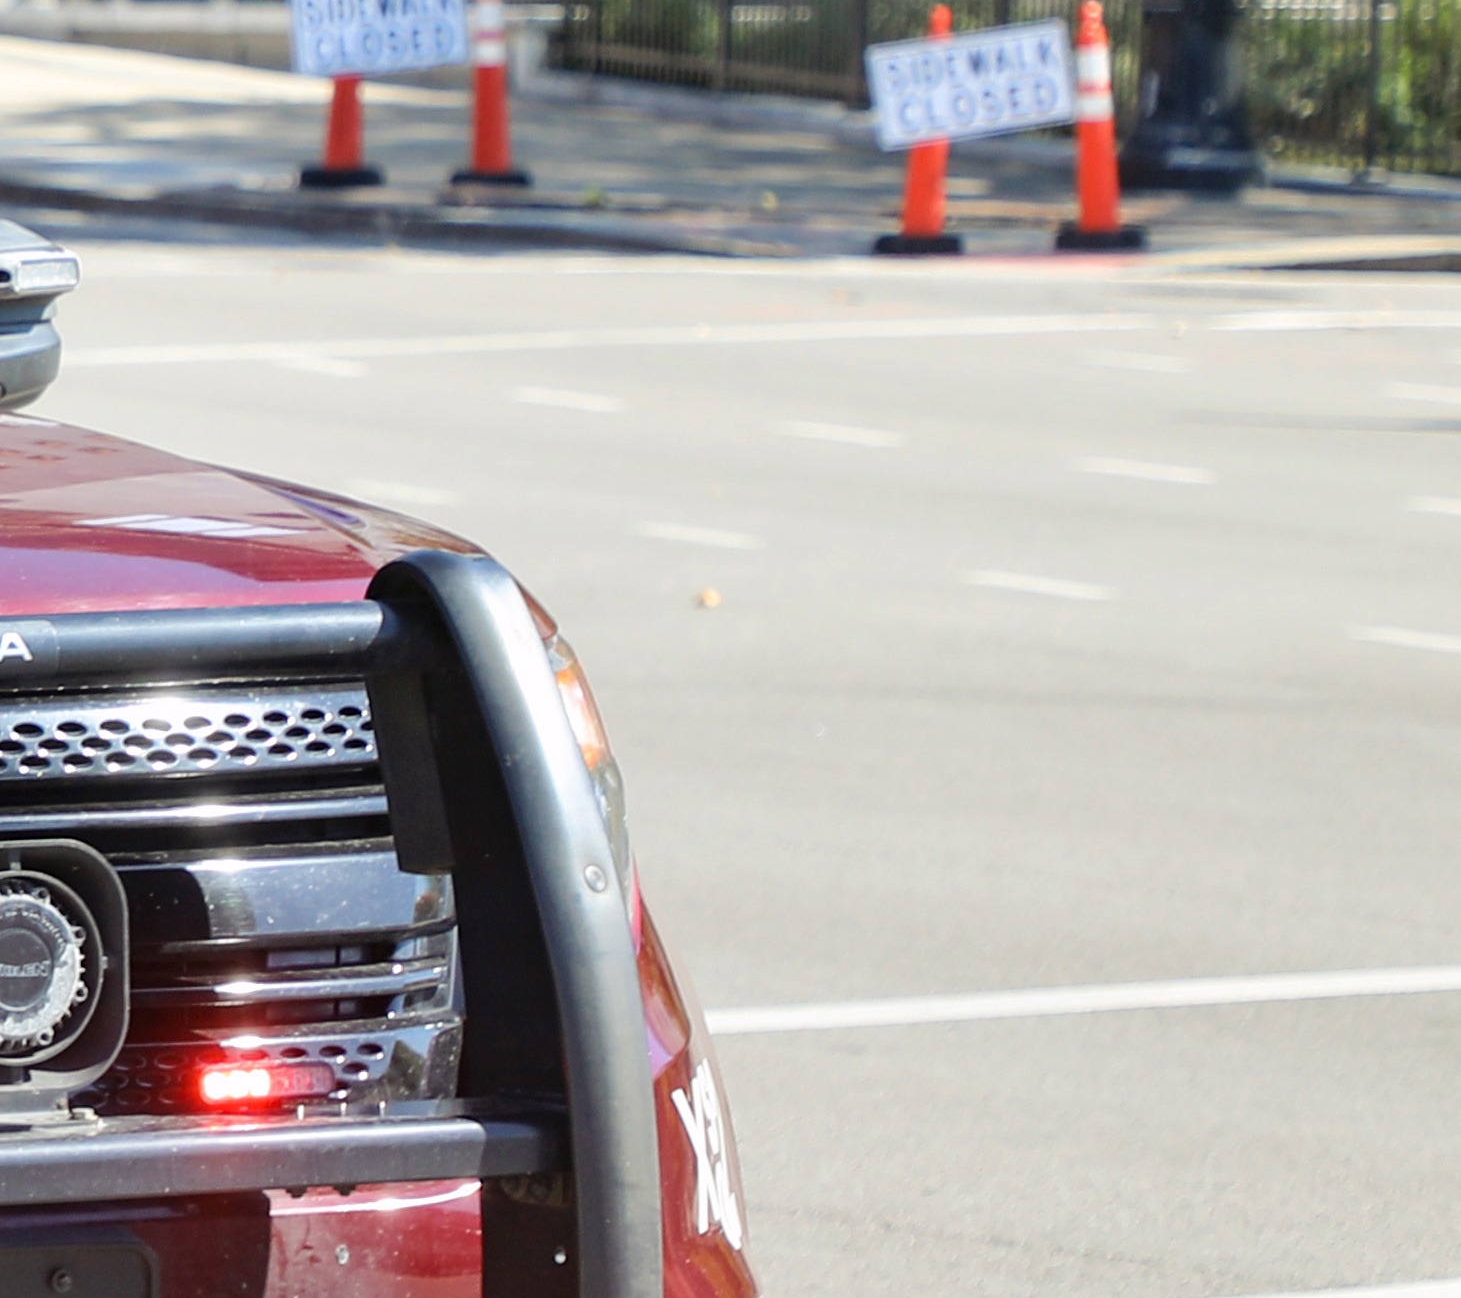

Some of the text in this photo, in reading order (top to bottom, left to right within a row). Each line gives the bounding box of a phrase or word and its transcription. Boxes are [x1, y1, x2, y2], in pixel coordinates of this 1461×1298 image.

[314, 20, 455, 68] CLOSED
[885, 36, 1060, 92] SIDEWALK
[899, 74, 1059, 131] CLOSED
